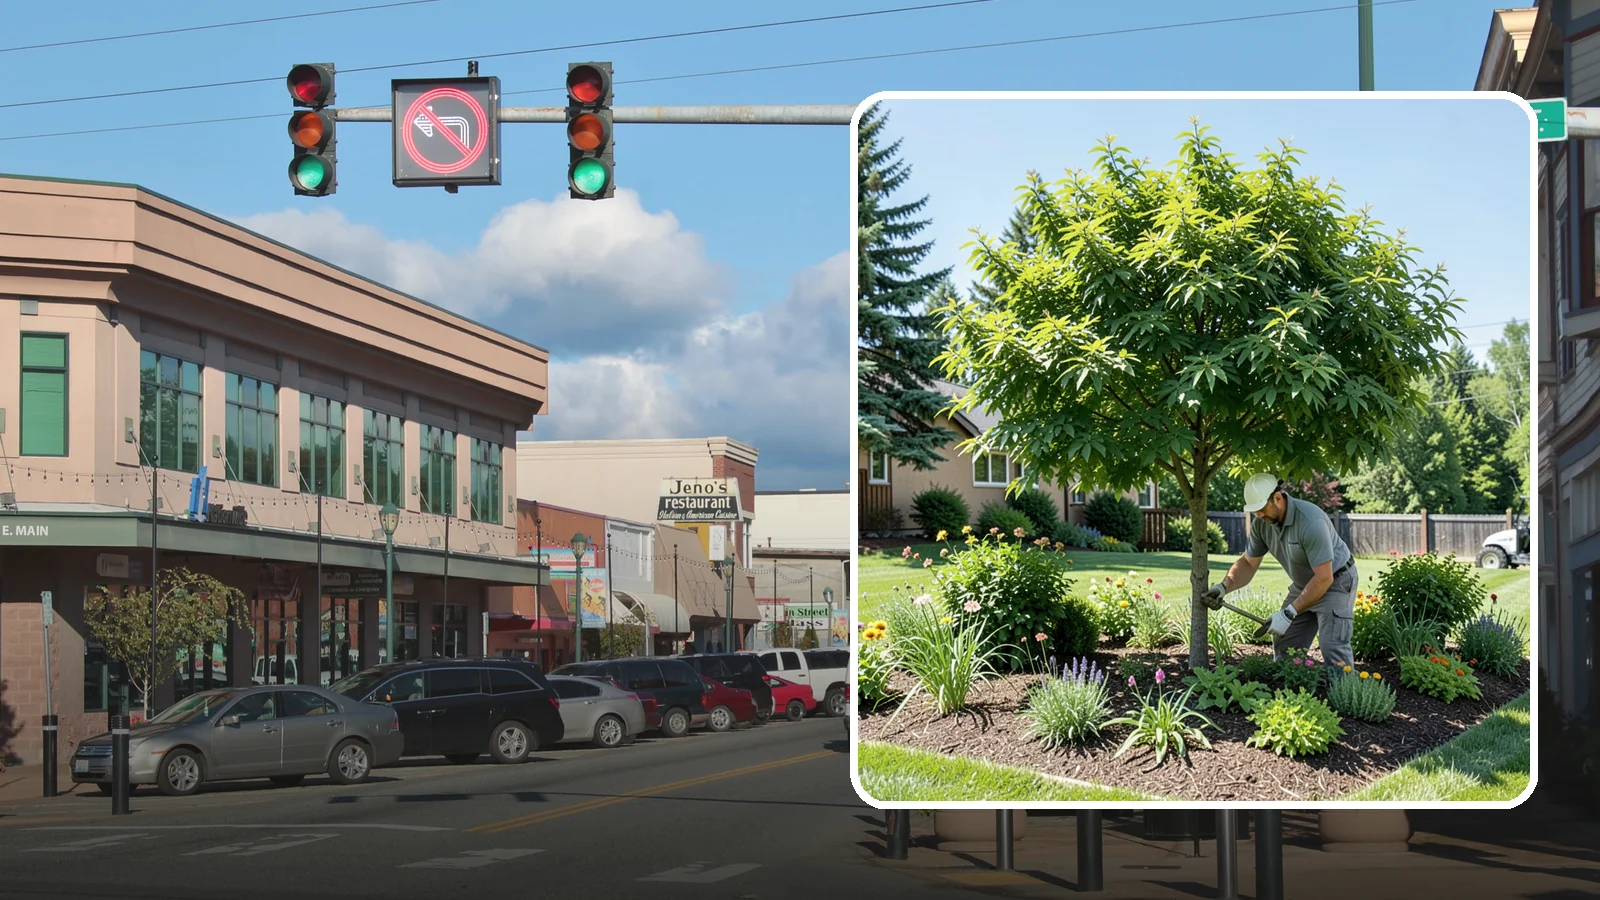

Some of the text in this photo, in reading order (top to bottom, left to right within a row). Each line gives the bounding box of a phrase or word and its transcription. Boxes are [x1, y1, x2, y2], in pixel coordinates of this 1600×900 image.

[670, 480, 727, 495] Jeno's
[665, 496, 731, 509] restaurant
[658, 509, 682, 520] Italian
[686, 509, 714, 519] American
[715, 509, 737, 519] Cuisine
[2, 525, 49, 536] E. MAIN
[798, 607, 828, 617] Street
[791, 619, 823, 627] lass
